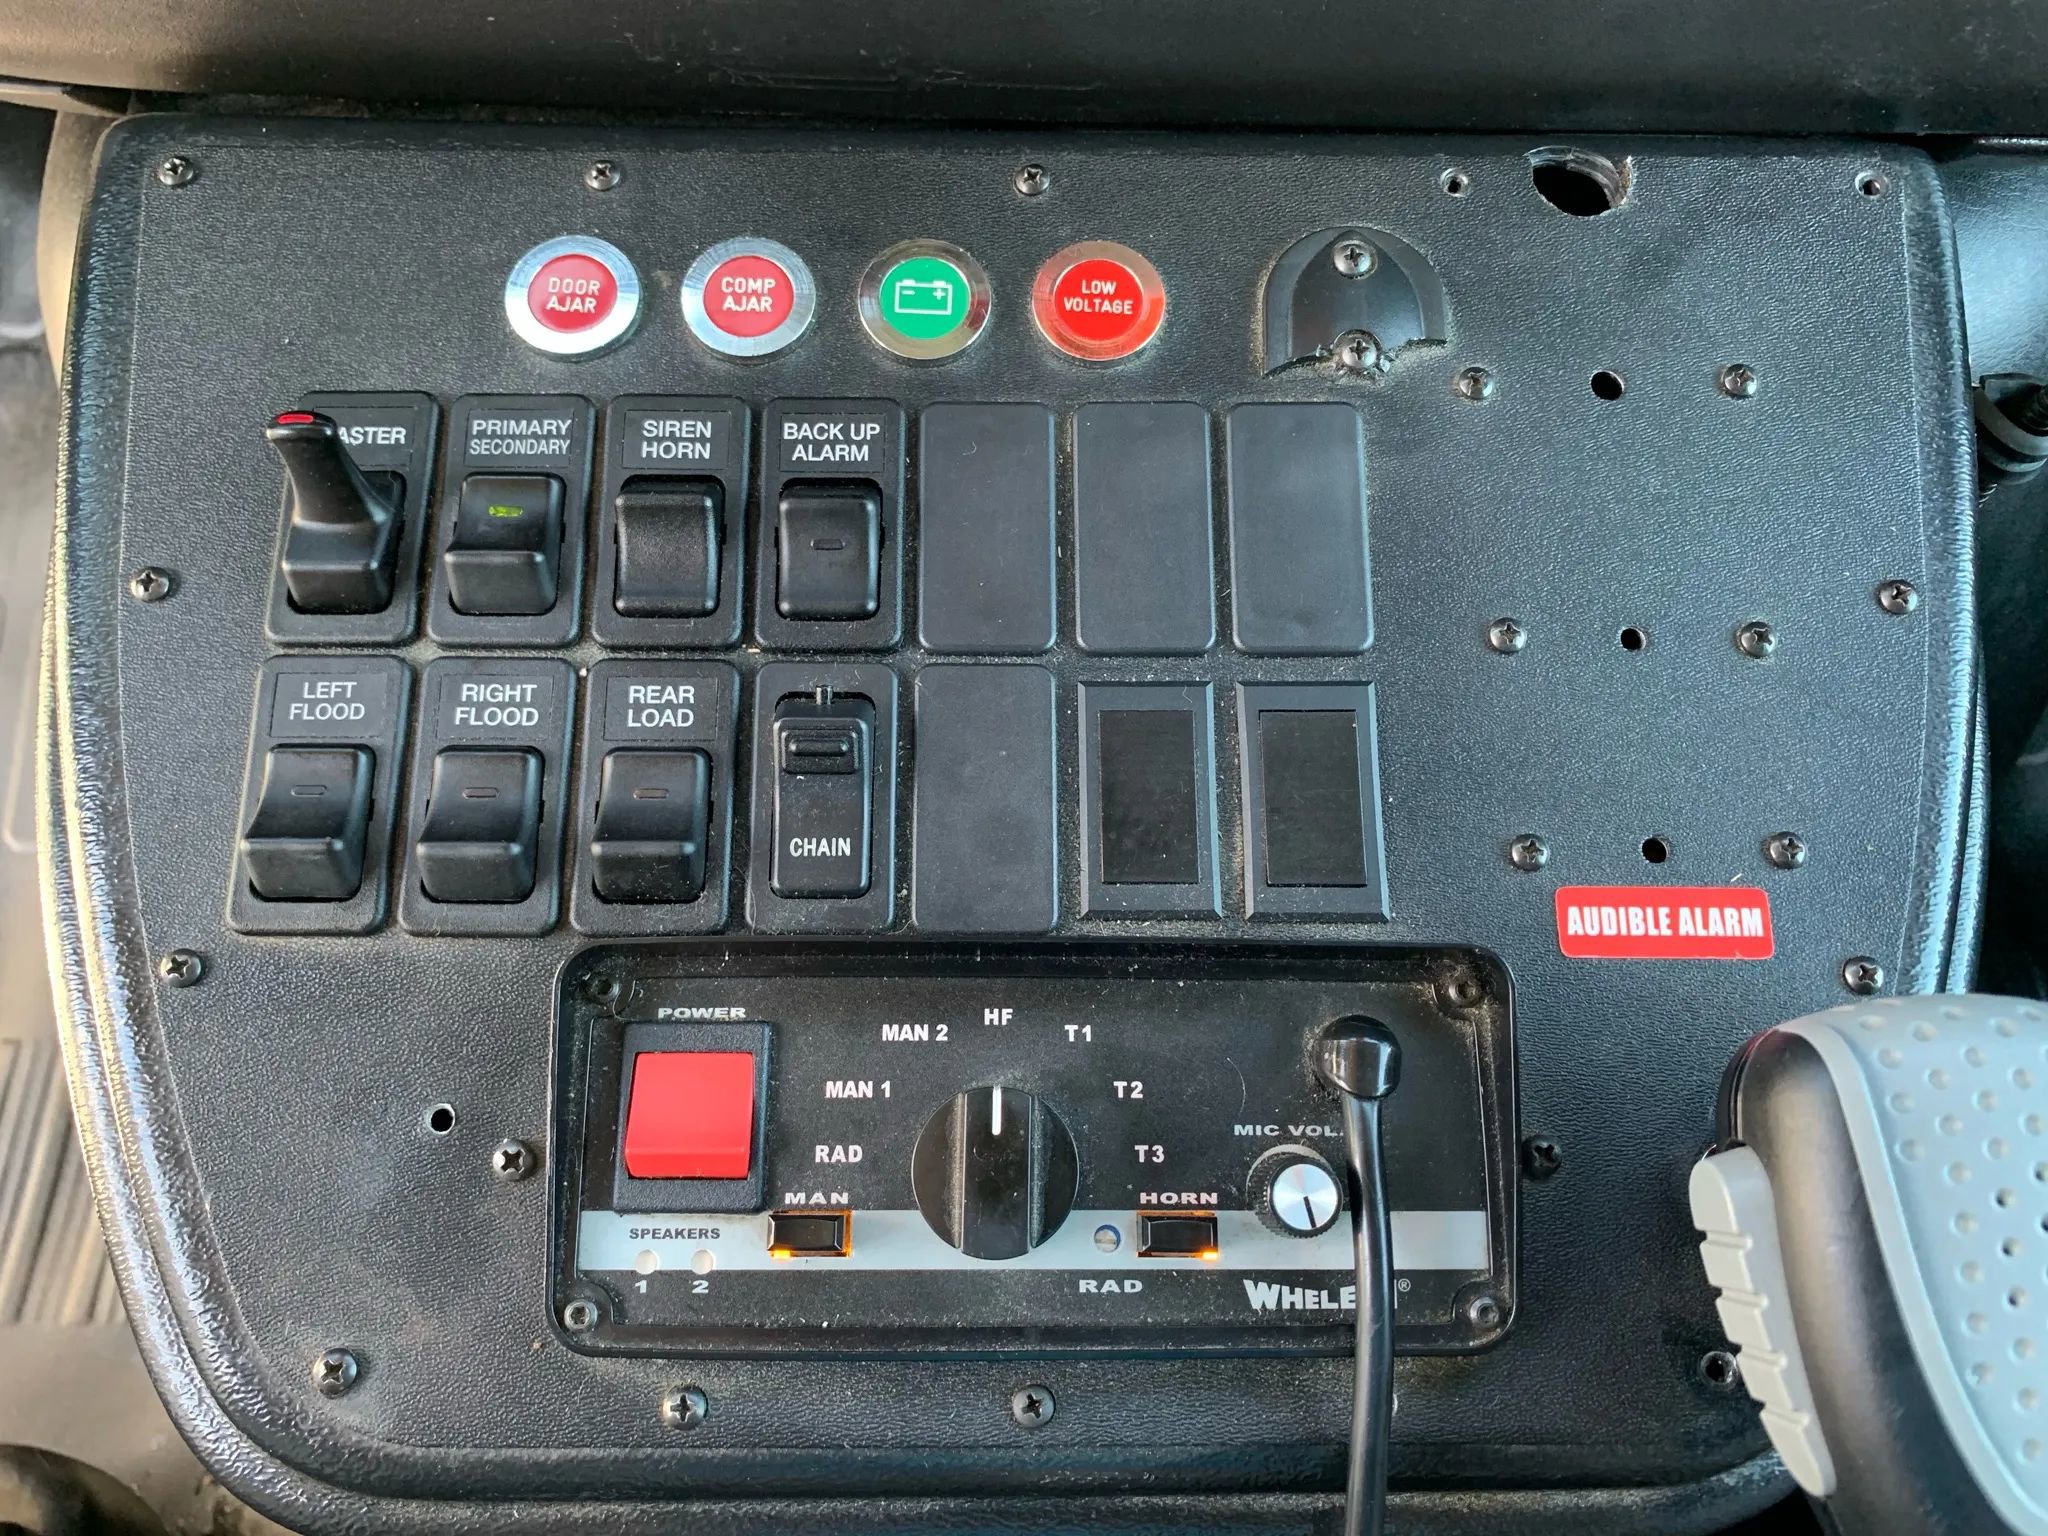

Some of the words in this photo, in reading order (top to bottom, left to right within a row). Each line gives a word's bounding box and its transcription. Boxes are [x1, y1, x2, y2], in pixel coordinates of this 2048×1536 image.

[547, 277, 601, 295] DOOR
[720, 276, 776, 294] COMP
[1081, 279, 1117, 296] LOW
[546, 295, 597, 315] AJAR
[722, 295, 773, 314] AJAR
[1064, 297, 1134, 315] VOLTAGE
[339, 426, 406, 445] ASTER
[472, 419, 571, 436] PRIMARY
[642, 420, 712, 439] SIREN
[783, 423, 845, 441] BACK
[850, 423, 881, 441] UP
[469, 438, 570, 455] SECONDARY
[641, 442, 711, 459] HORN
[792, 444, 869, 462] ALARM
[303, 681, 357, 699] LEFT
[461, 683, 537, 702] RIGHT
[628, 685, 695, 704] REAR
[289, 703, 365, 720] FLOOD
[455, 707, 539, 726] FLOOD
[627, 709, 695, 728] LOAD
[789, 837, 851, 857] CHAIN
[1567, 906, 1673, 936] AUDIBLE
[1679, 907, 1764, 937] ALARM
[657, 1007, 747, 1019] POWER
[984, 1008, 1013, 1025] HF
[881, 1024, 929, 1041] MAN
[935, 1024, 948, 1041] 2
[1064, 1025, 1092, 1042] T1
[825, 1080, 873, 1098] MAN
[880, 1080, 892, 1098] 1
[1113, 1081, 1144, 1099] T2
[1234, 1124, 1279, 1136] MIC
[815, 1145, 863, 1163] RAD
[1134, 1145, 1165, 1163] T3
[785, 1192, 849, 1204] MAN
[1139, 1192, 1218, 1205] HORN
[629, 1227, 721, 1240] SPEAKERS
[634, 1280, 647, 1293] 1
[692, 1280, 709, 1293] 2
[1078, 1279, 1143, 1293] RAD
[1243, 1279, 1398, 1311] WHELE
